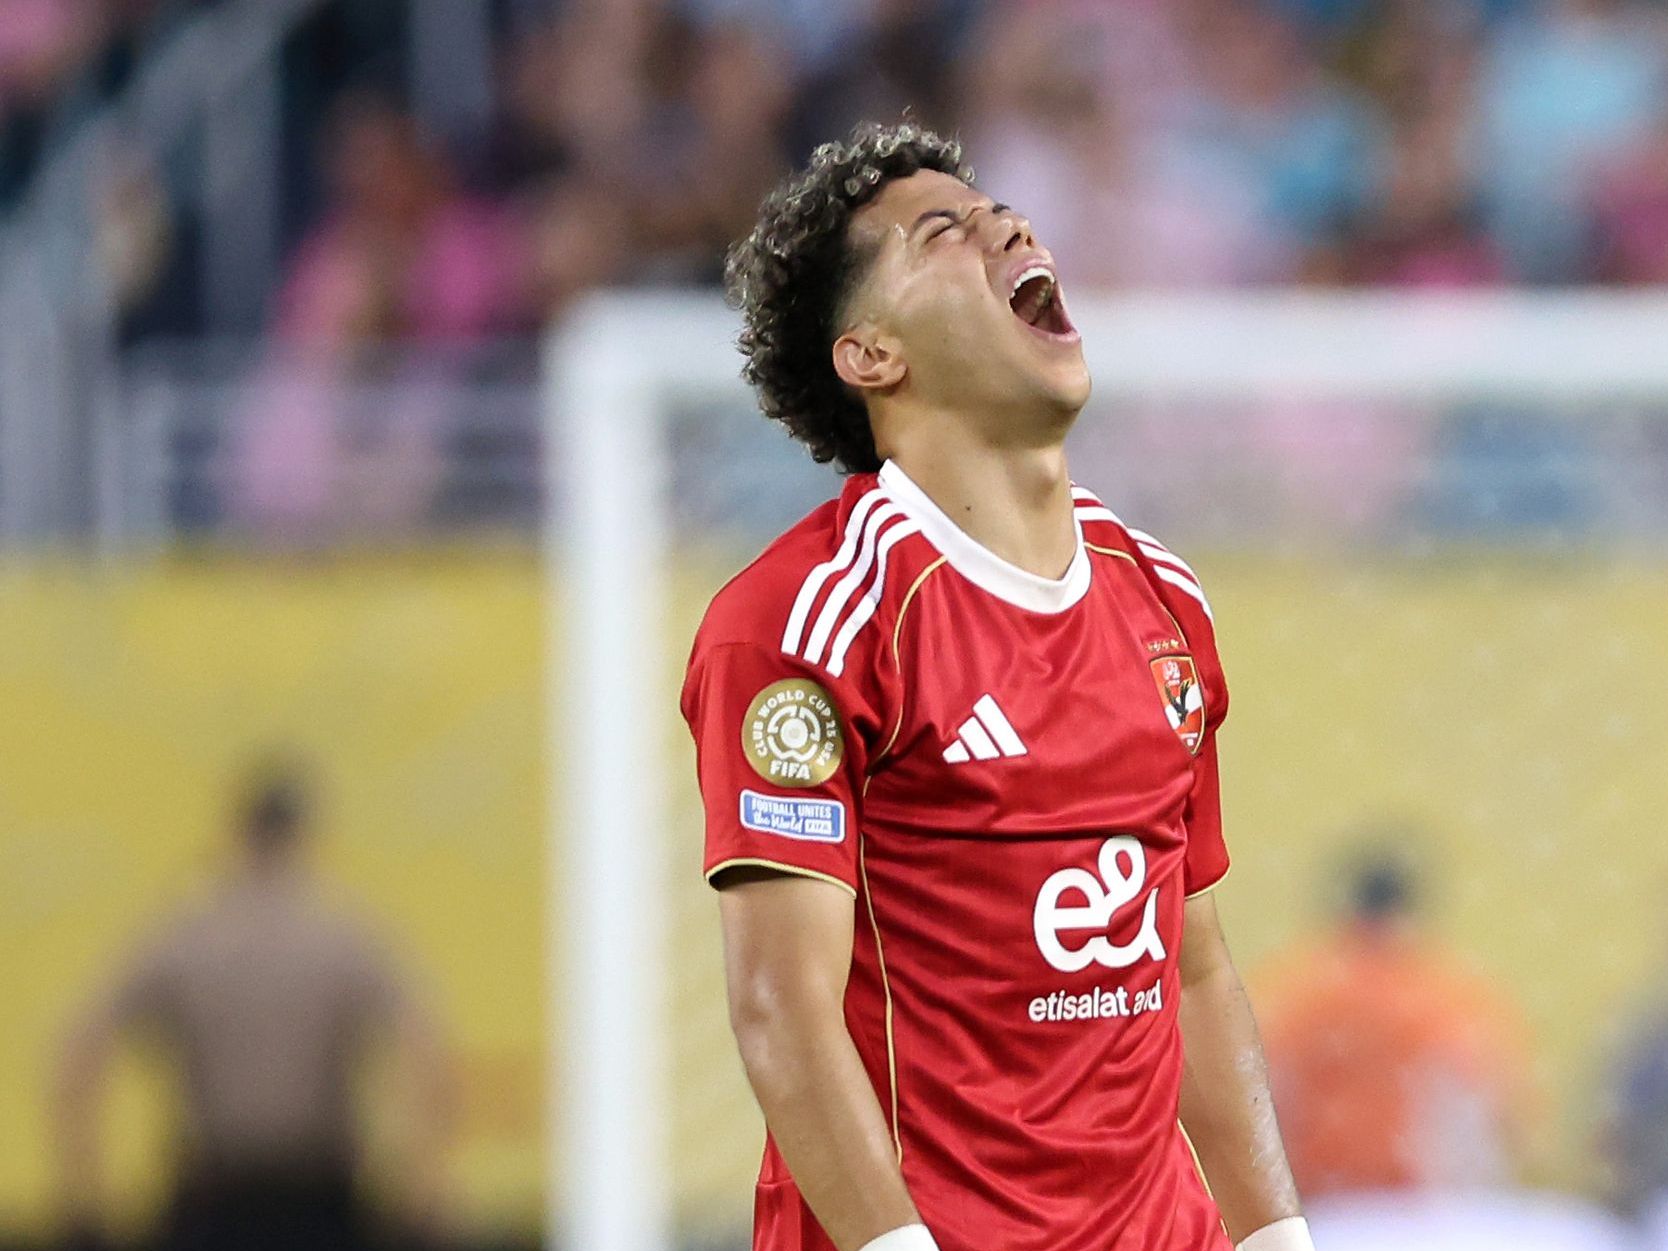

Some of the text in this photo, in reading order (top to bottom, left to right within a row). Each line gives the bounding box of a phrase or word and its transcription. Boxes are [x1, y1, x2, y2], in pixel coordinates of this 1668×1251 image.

[757, 690, 805, 718] WORLD
[808, 695, 831, 717] CUP
[752, 721, 768, 757] CLUB
[770, 760, 810, 779] FIFA
[752, 798, 832, 818] FOOTBALL UNITES
[1028, 986, 1130, 1022] etisalat
